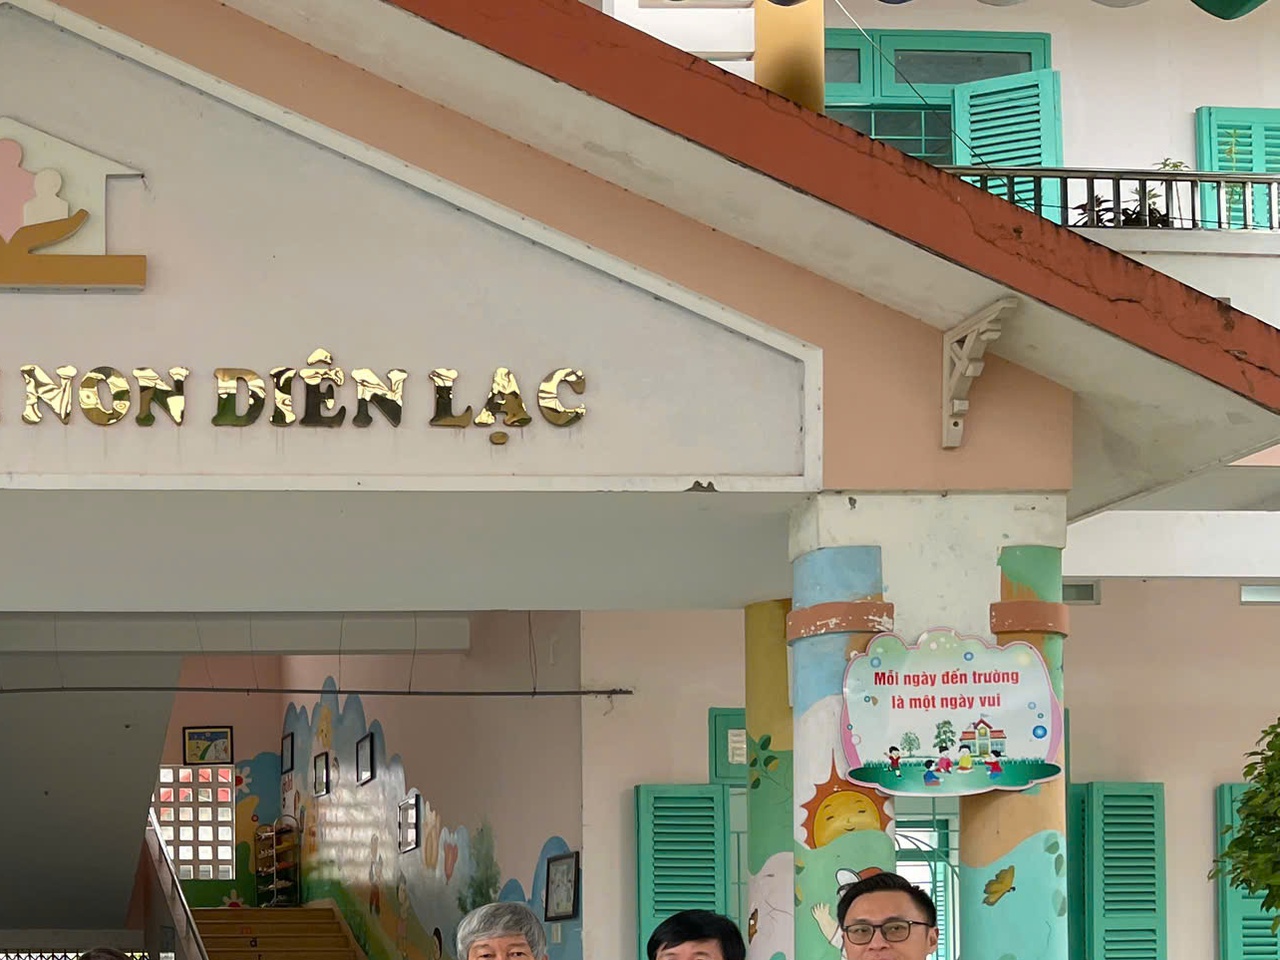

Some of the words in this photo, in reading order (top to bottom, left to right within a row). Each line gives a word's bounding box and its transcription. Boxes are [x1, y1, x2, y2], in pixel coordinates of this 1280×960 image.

[20, 365, 190, 427] NON
[211, 347, 404, 428] DIÊN
[427, 366, 587, 445] LẠC
[903, 671, 937, 687] ngày
[941, 668, 968, 684] đến
[972, 669, 1019, 684] trường
[891, 694, 905, 709] là
[909, 694, 936, 711] một
[940, 694, 974, 710] ngày
[979, 693, 1001, 707] vui
